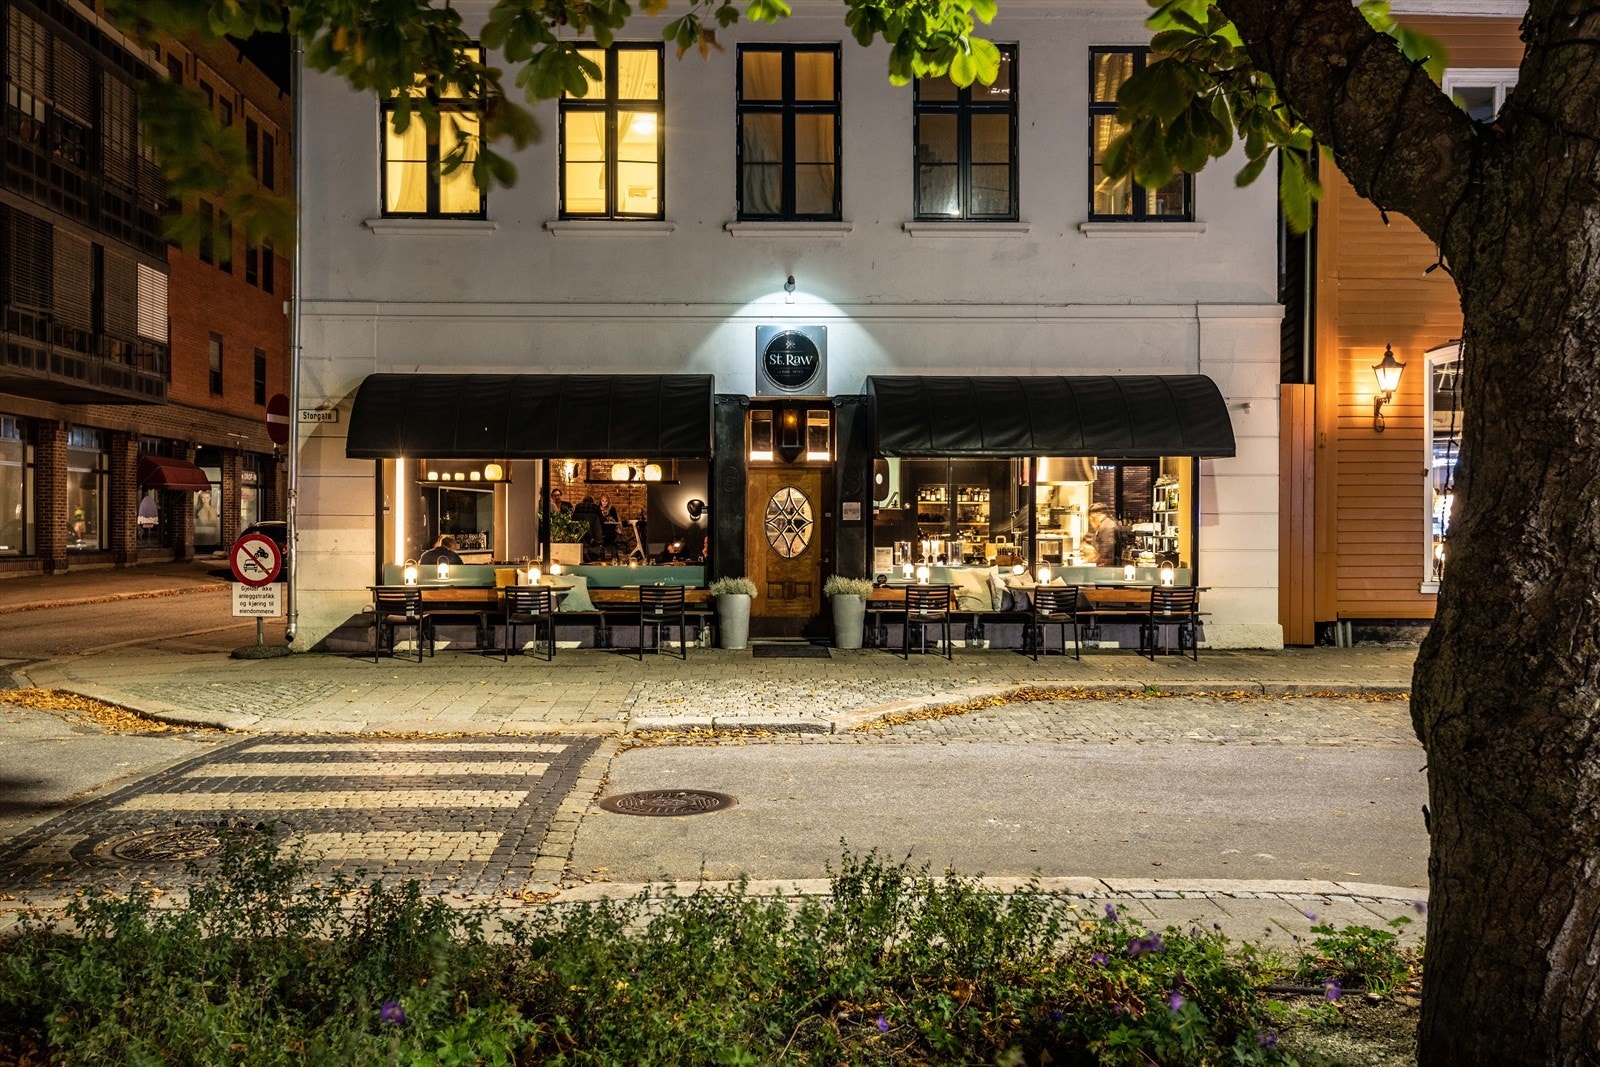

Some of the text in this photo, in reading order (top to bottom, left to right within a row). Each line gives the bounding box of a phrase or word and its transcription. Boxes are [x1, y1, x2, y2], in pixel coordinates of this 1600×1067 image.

[769, 353, 813, 366] St. Raw
[303, 412, 331, 421] Storgata
